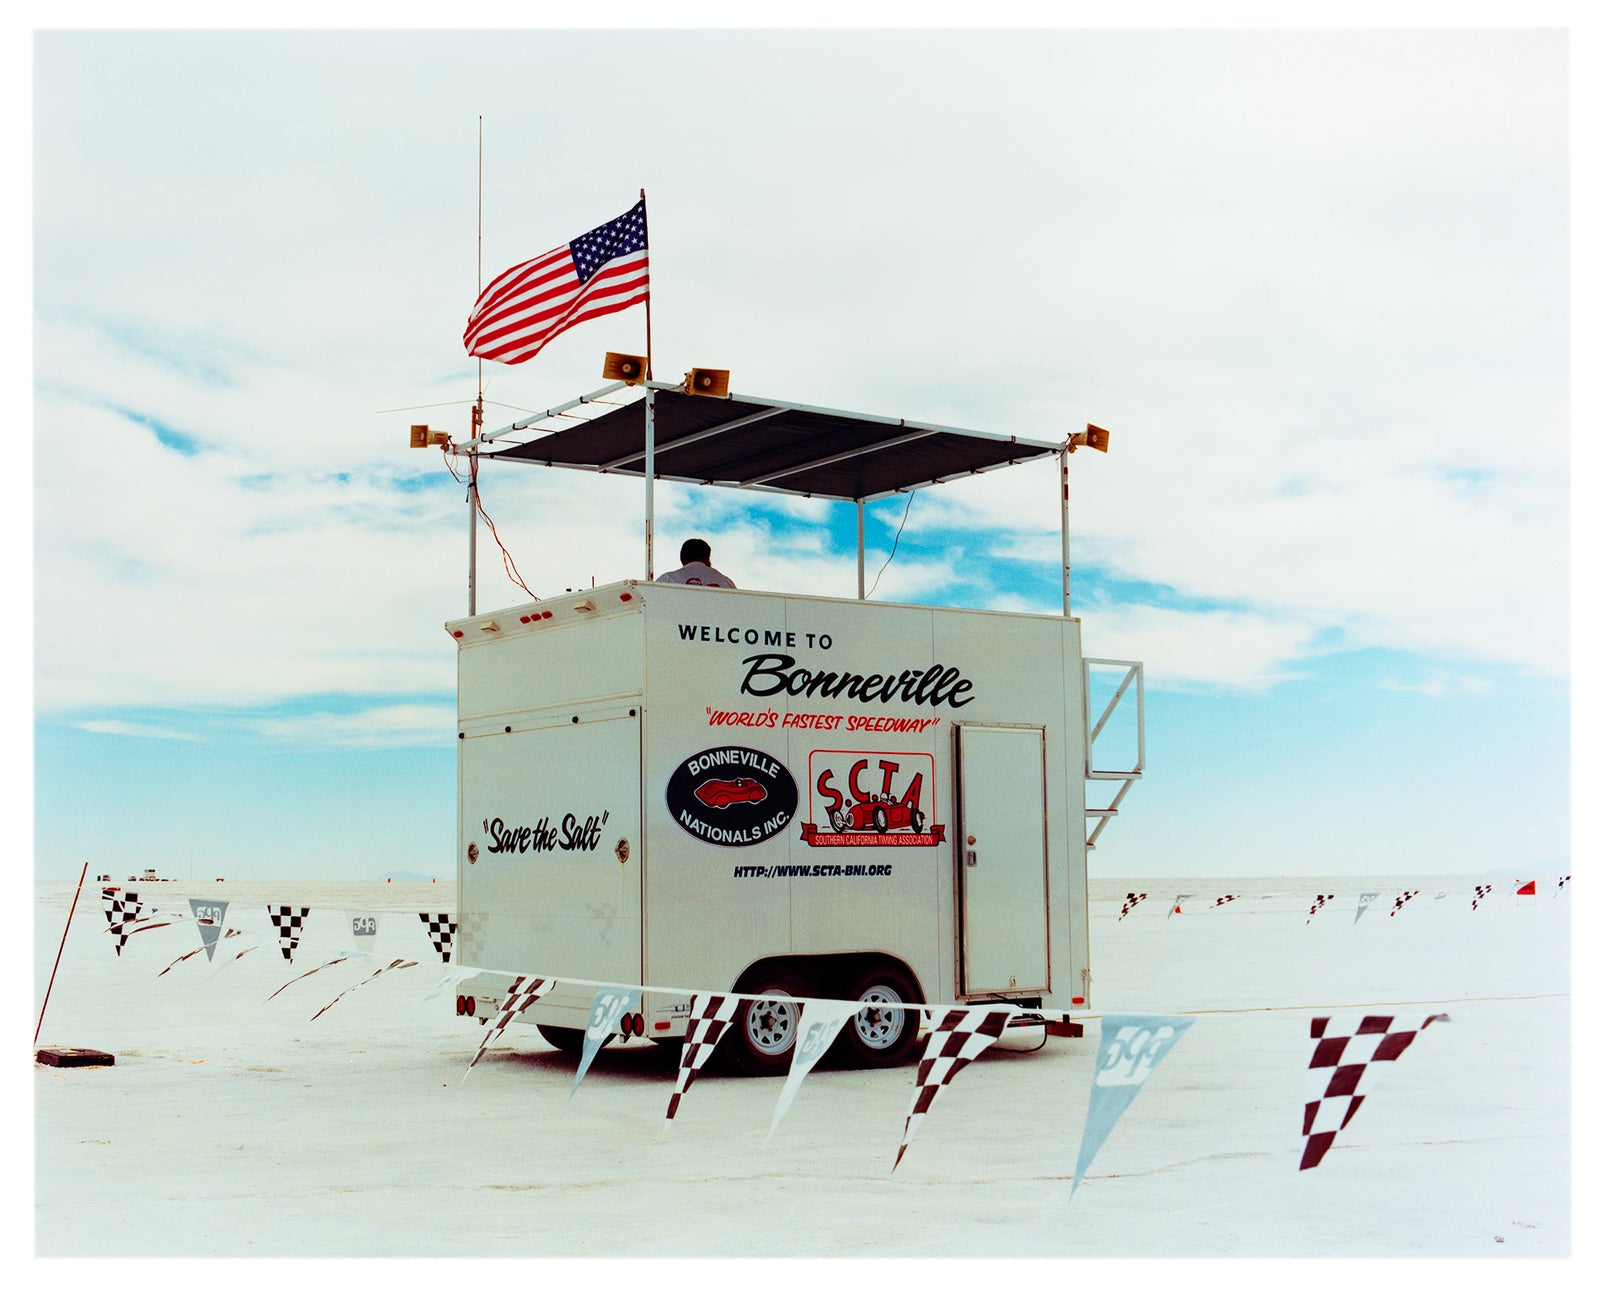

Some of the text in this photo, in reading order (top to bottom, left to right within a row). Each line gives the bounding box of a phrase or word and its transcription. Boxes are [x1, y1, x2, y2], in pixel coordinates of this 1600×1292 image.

[678, 624, 833, 650] WELCOME TO
[740, 653, 976, 709] Bonneville
[781, 712, 844, 731] FASTEST
[846, 714, 941, 734] SPEEDWAY"
[687, 749, 781, 779] BONNEVILLE
[482, 809, 610, 855] "Save the Salt"
[679, 808, 790, 843] NATIONALS INC.
[815, 834, 933, 846] SOUTHERN CALIFORNIA TIMING ASSOCIATION
